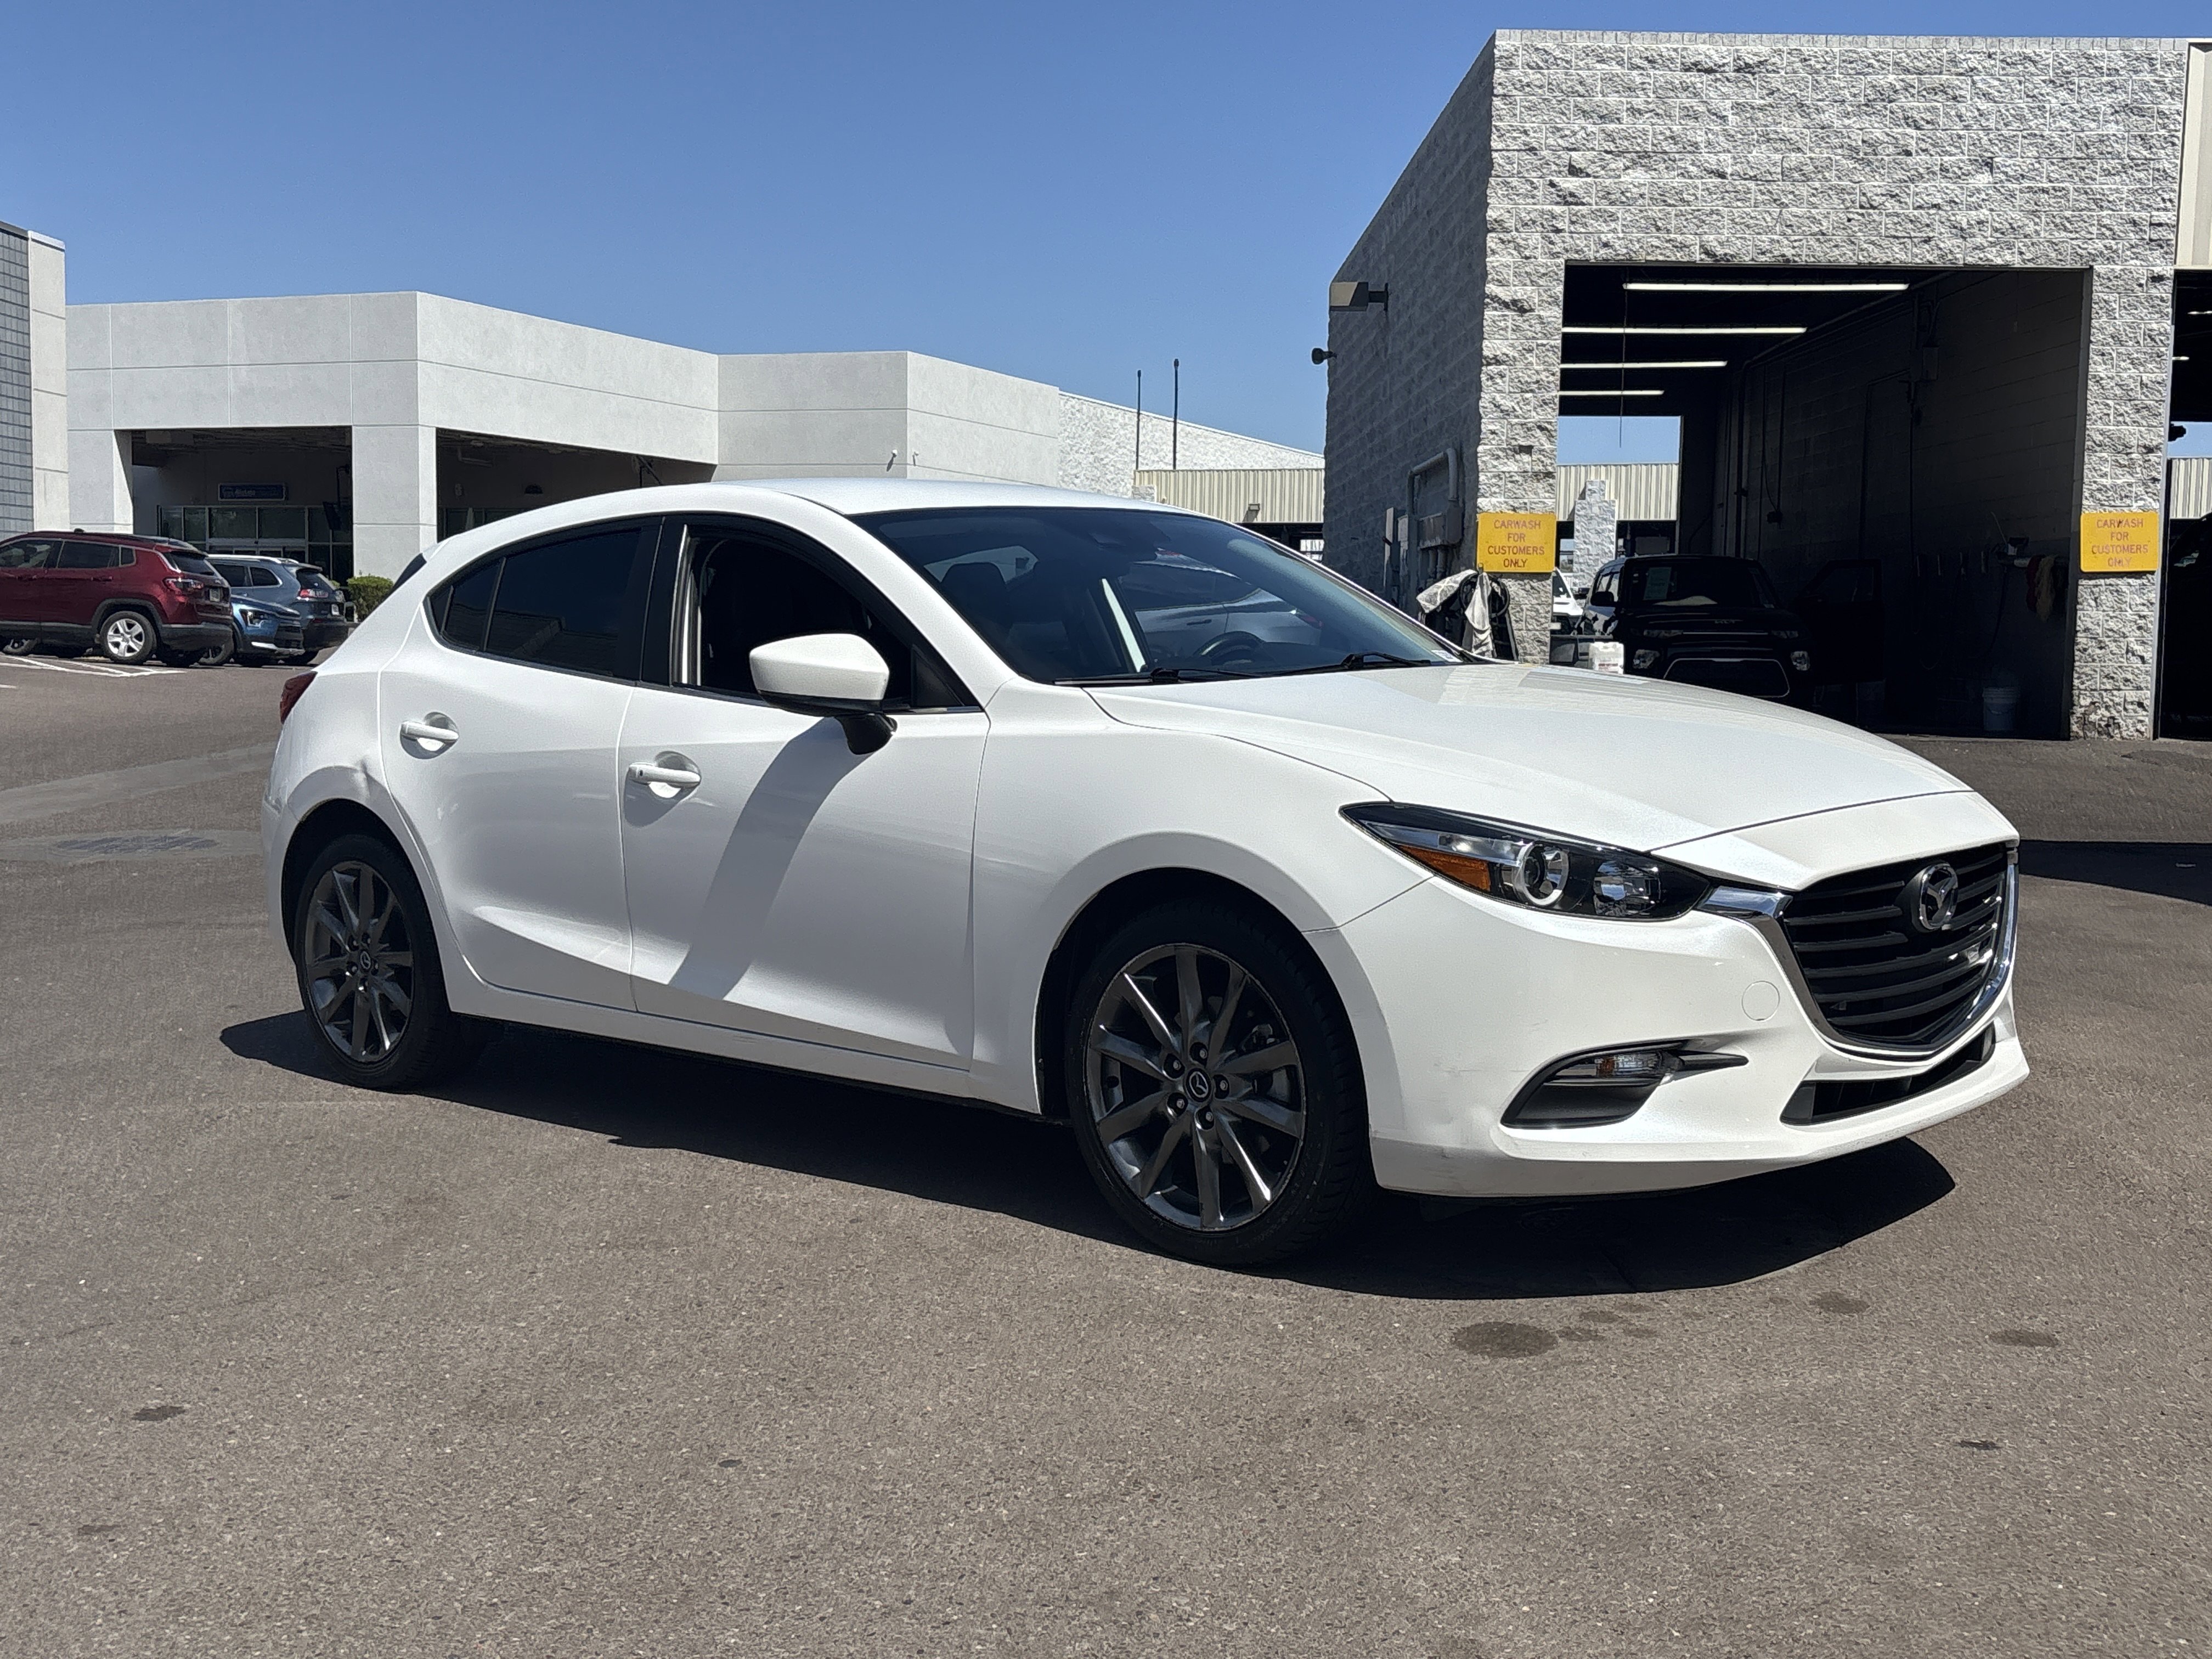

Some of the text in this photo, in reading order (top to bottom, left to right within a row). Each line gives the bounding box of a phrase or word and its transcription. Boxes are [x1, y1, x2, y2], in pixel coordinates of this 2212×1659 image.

[1494, 520, 1541, 529] CARWASH
[2097, 518, 2143, 528] CARWASH
[1508, 533, 1526, 542] FOR
[2111, 532, 2129, 541] FOR
[1488, 545, 1545, 555] CUSTOMERS
[2091, 544, 2148, 554] CUSTOMERS
[1503, 558, 1528, 568] ONLY
